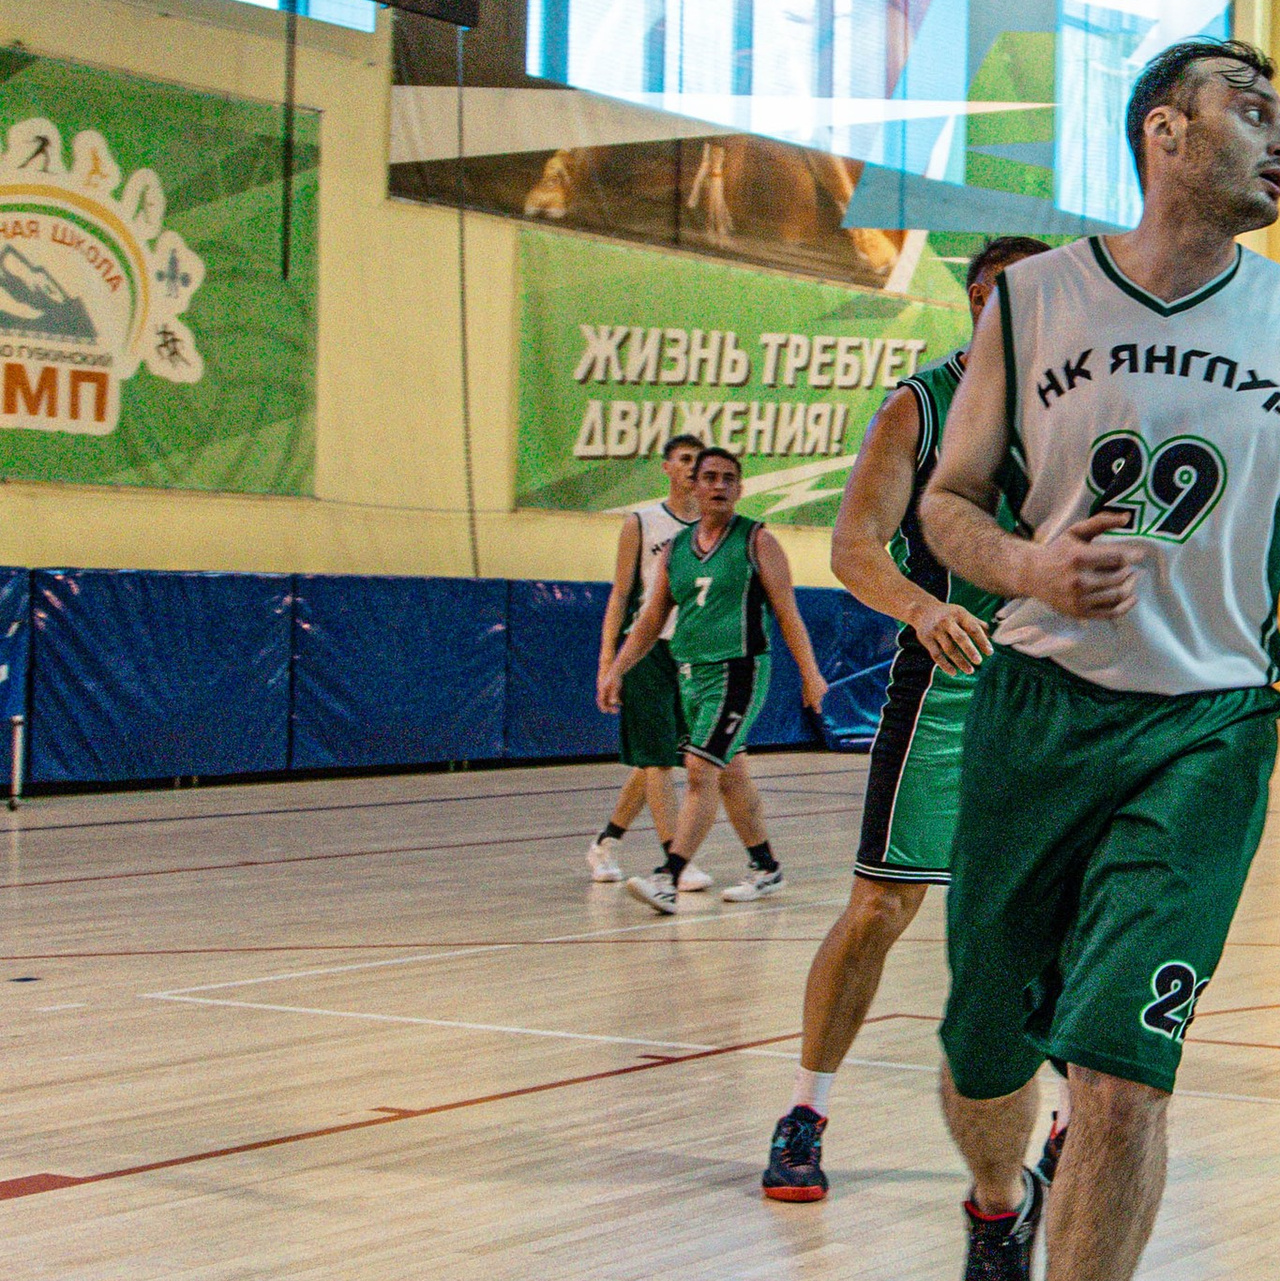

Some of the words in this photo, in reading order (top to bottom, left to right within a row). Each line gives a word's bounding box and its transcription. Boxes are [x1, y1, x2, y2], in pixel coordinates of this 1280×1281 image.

[573, 324, 751, 388] ЖИЗНЬ
[759, 332, 927, 389] ТРЕБУЕТ
[1036, 347, 1094, 409] НК
[3, 362, 109, 422] МП
[573, 399, 849, 460] ДВИЖЕНИЯ!
[1086, 428, 1227, 544] 29
[694, 576, 714, 608] 7
[725, 711, 744, 736] 7
